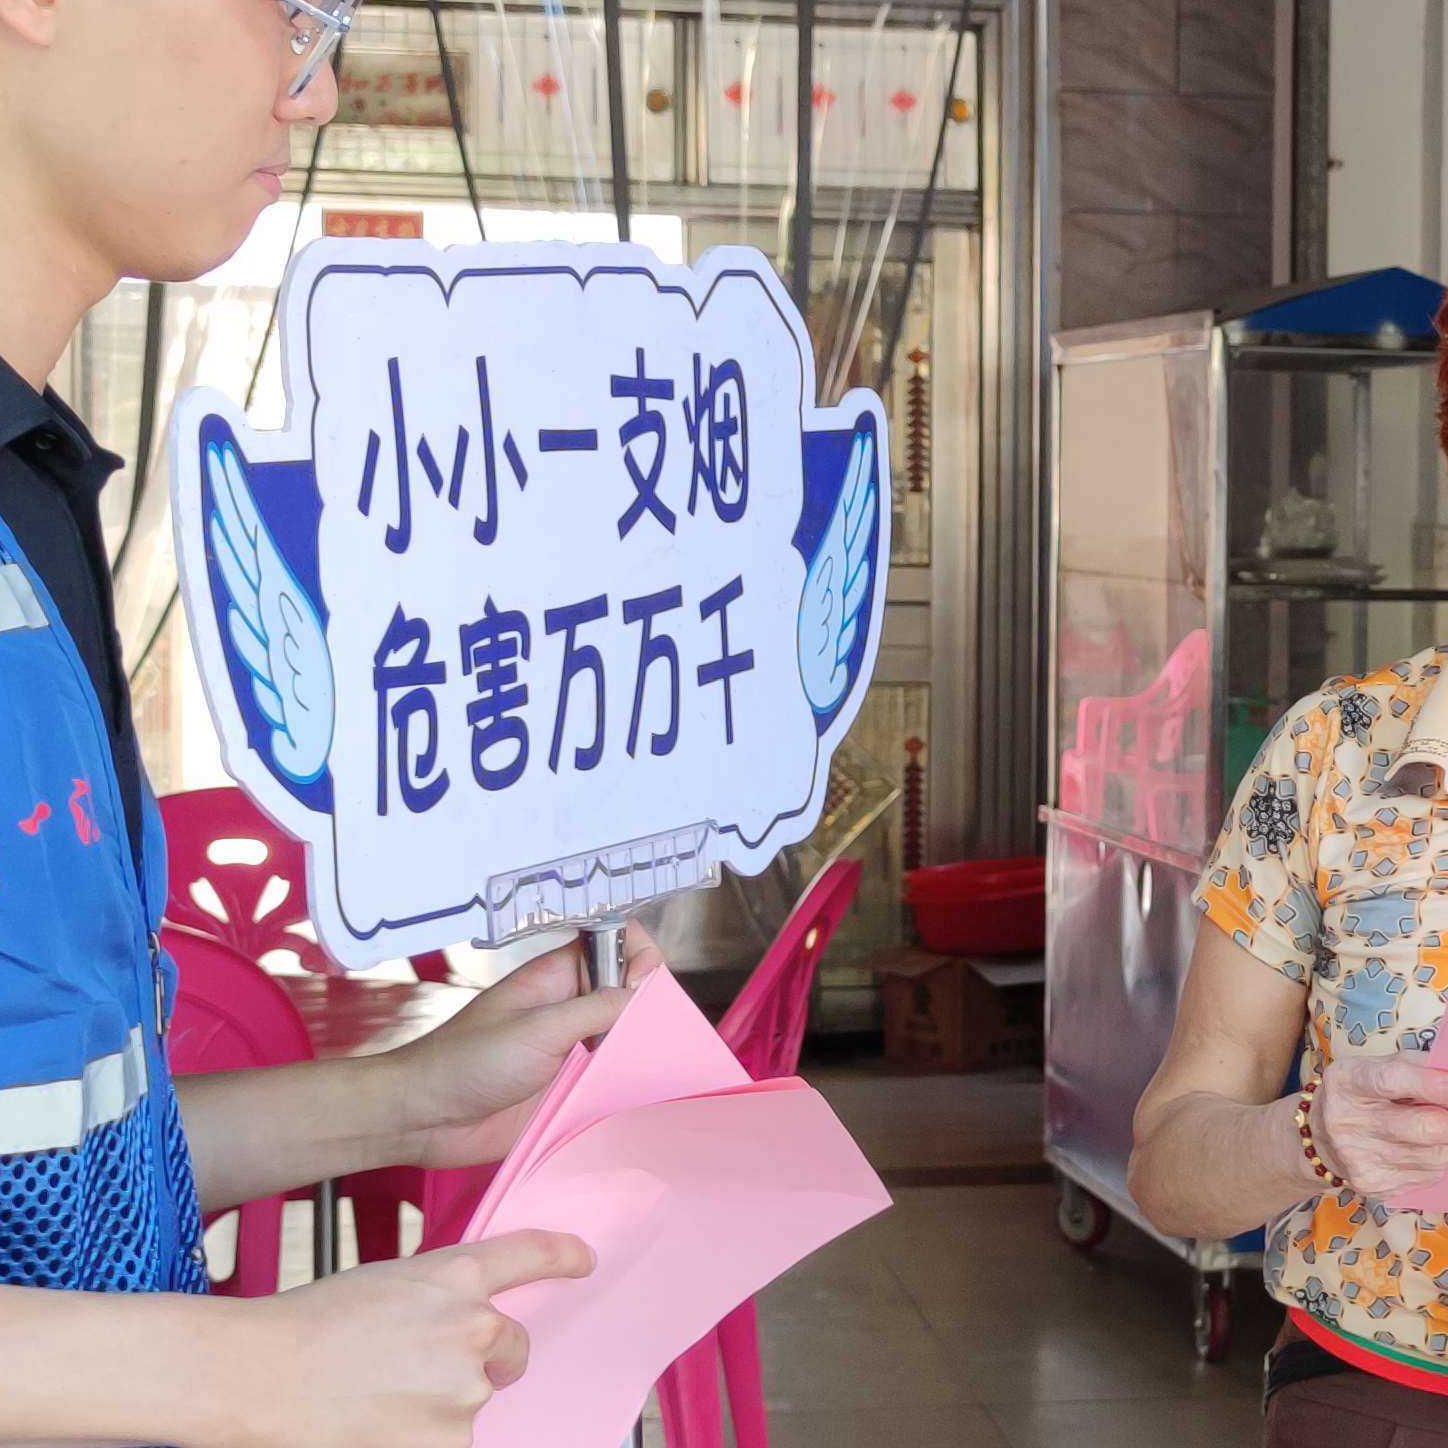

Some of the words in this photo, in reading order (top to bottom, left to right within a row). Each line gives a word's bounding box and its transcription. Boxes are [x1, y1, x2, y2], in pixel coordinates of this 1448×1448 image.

[357, 348, 750, 554] 小小一支烟
[372, 575, 754, 817] 危害万万千
